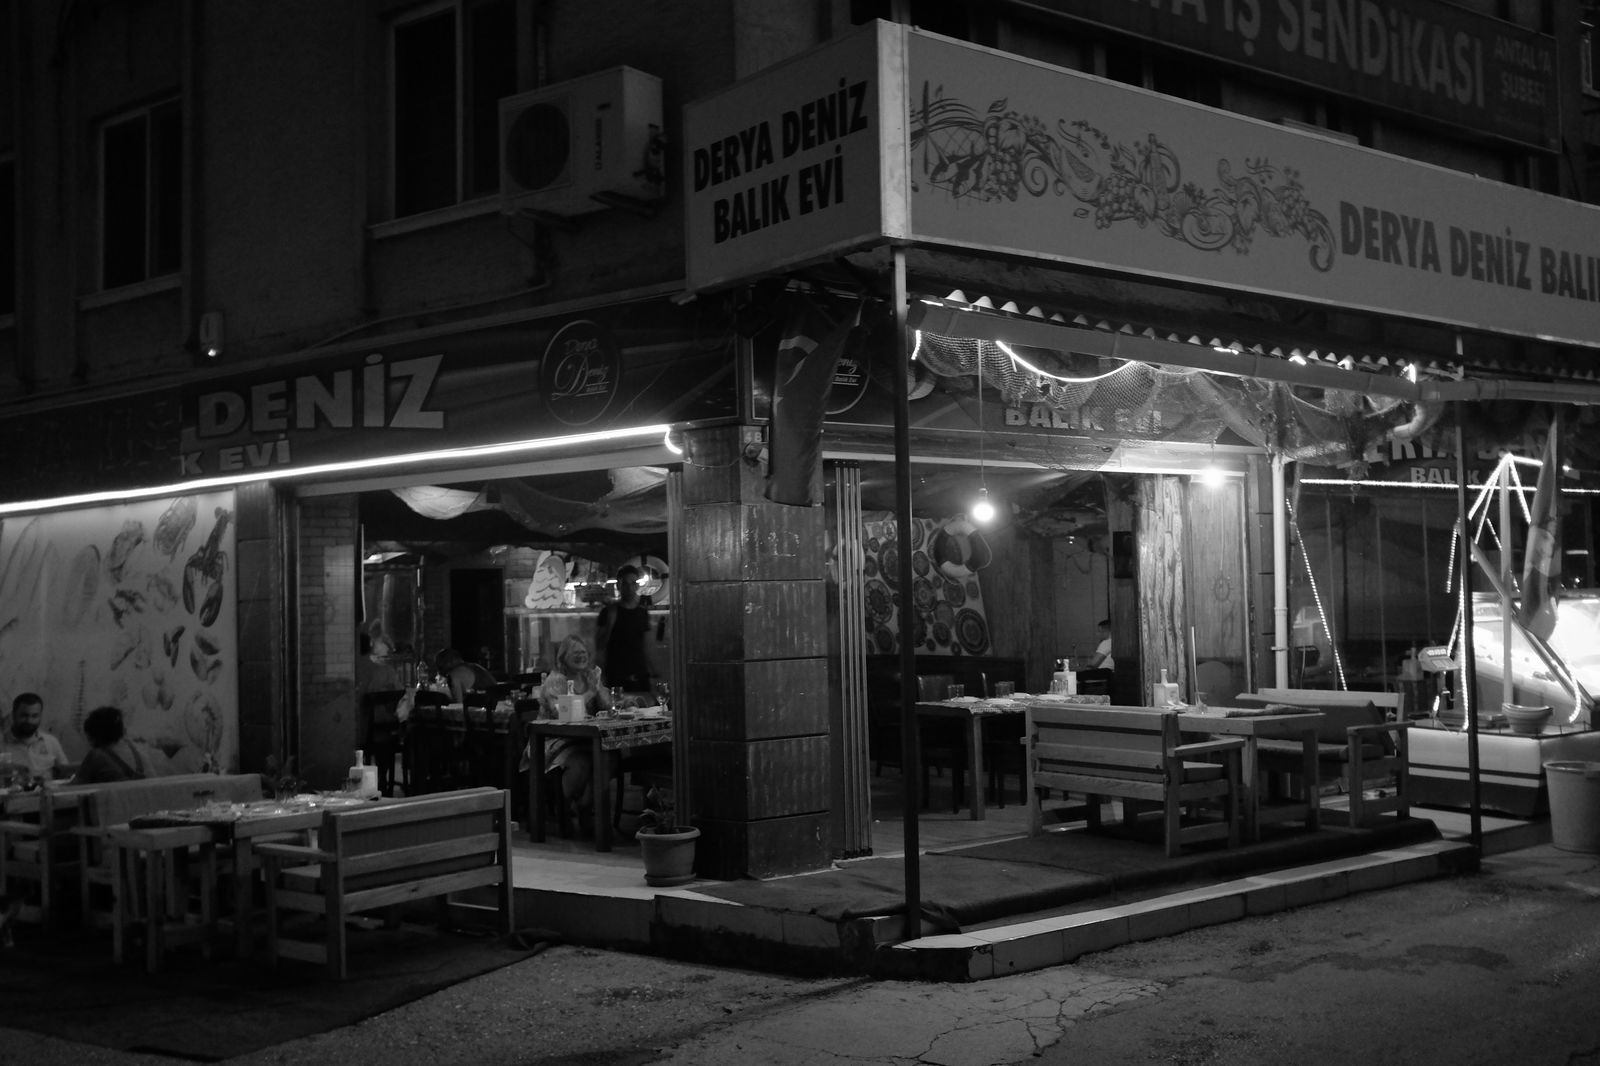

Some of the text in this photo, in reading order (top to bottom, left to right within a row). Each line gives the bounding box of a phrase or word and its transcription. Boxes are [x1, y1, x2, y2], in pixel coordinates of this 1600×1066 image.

[694, 121, 774, 192] DERYA
[782, 77, 868, 158] DENİZ
[714, 144, 844, 244] BALIK EVİ
[1340, 201, 1600, 302] DERYA DENİZ BALI
[199, 353, 445, 437] DENİZ
[220, 433, 291, 472] EVİ
[1411, 466, 1480, 485] BALK
